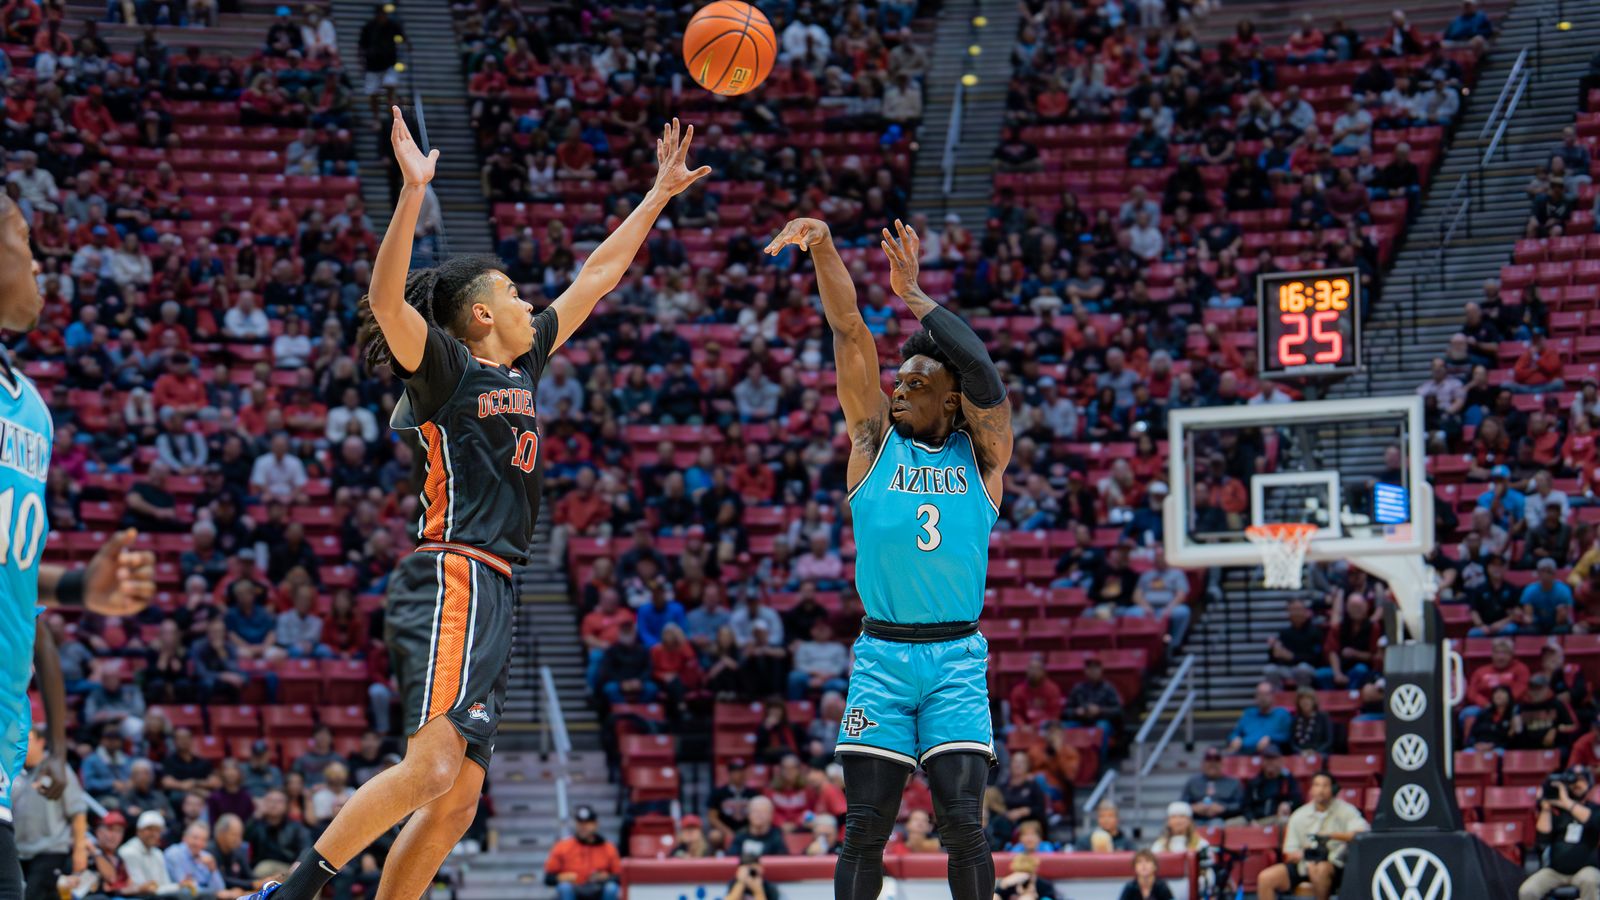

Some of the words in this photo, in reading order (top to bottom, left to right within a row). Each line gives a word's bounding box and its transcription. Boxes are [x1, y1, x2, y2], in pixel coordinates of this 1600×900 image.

[1280, 279, 1350, 313] 16:32
[1278, 311, 1343, 365] 25
[511, 427, 538, 473] 10
[888, 463, 968, 495] AZTECS
[0, 487, 45, 570] 10
[916, 503, 942, 552] 3
